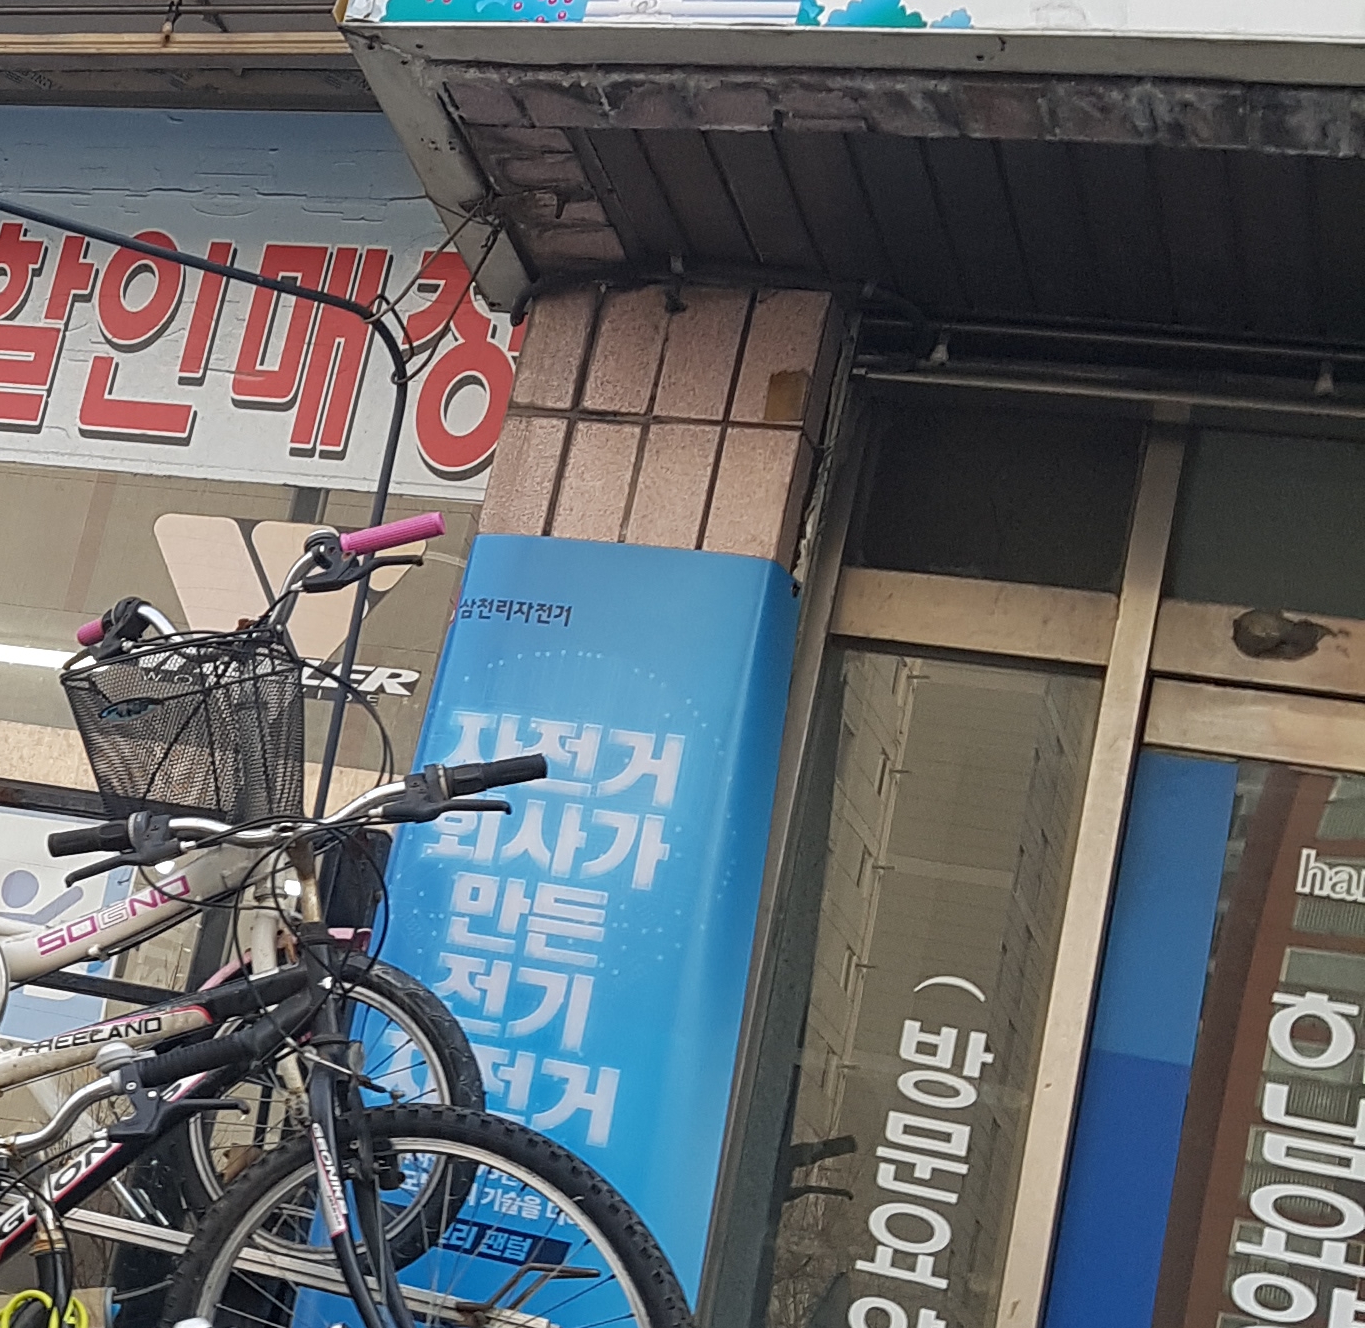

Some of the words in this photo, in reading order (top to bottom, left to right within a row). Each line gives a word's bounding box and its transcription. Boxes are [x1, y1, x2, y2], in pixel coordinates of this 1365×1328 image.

[458, 596, 572, 626] 삼천리자전거
[37, 874, 190, 956] SOGNO
[446, 872, 609, 968] 만든
[434, 951, 595, 1057] 전기
